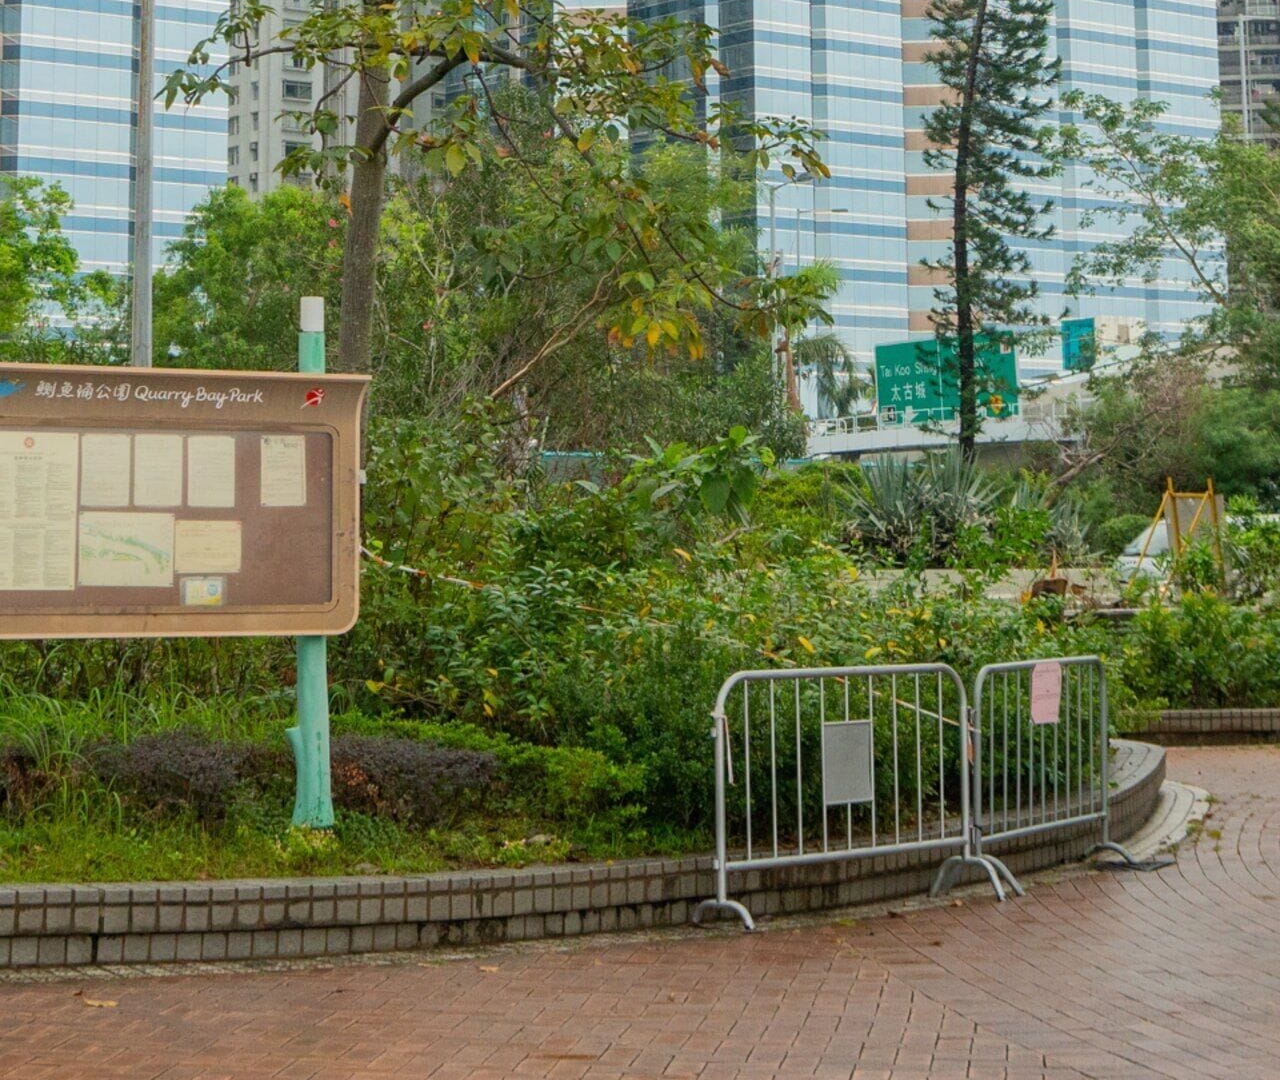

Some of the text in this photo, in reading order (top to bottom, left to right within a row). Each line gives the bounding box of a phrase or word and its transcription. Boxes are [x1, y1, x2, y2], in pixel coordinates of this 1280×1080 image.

[880, 365, 893, 378] Tai
[894, 364, 911, 377] Koo
[34, 380, 263, 409] 鰂魚涌公園 Quarry Bay Park
[890, 381, 926, 401] 太古城
